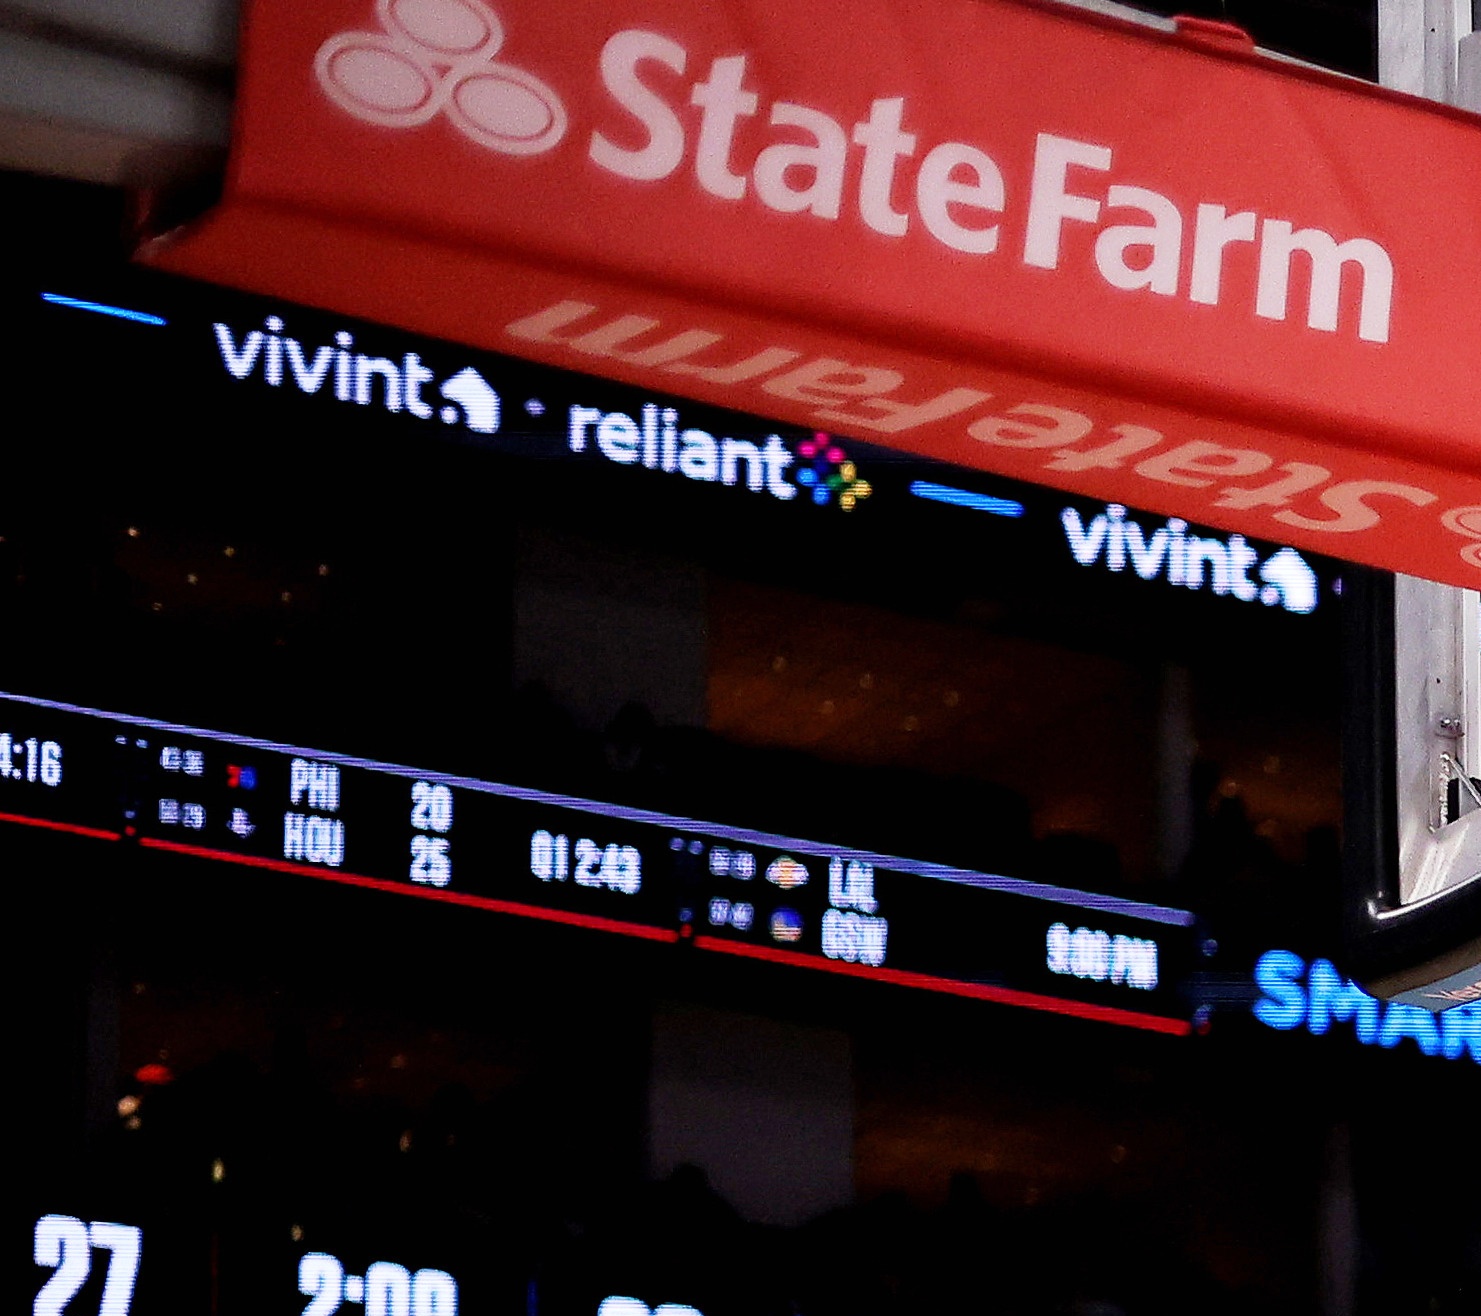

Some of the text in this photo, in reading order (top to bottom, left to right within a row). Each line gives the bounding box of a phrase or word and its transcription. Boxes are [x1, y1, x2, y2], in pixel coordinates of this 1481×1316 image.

[213, 315, 1258, 601] vivint reliant vivint
[290, 757, 453, 833] PHI 20
[284, 810, 451, 887] HOU 25
